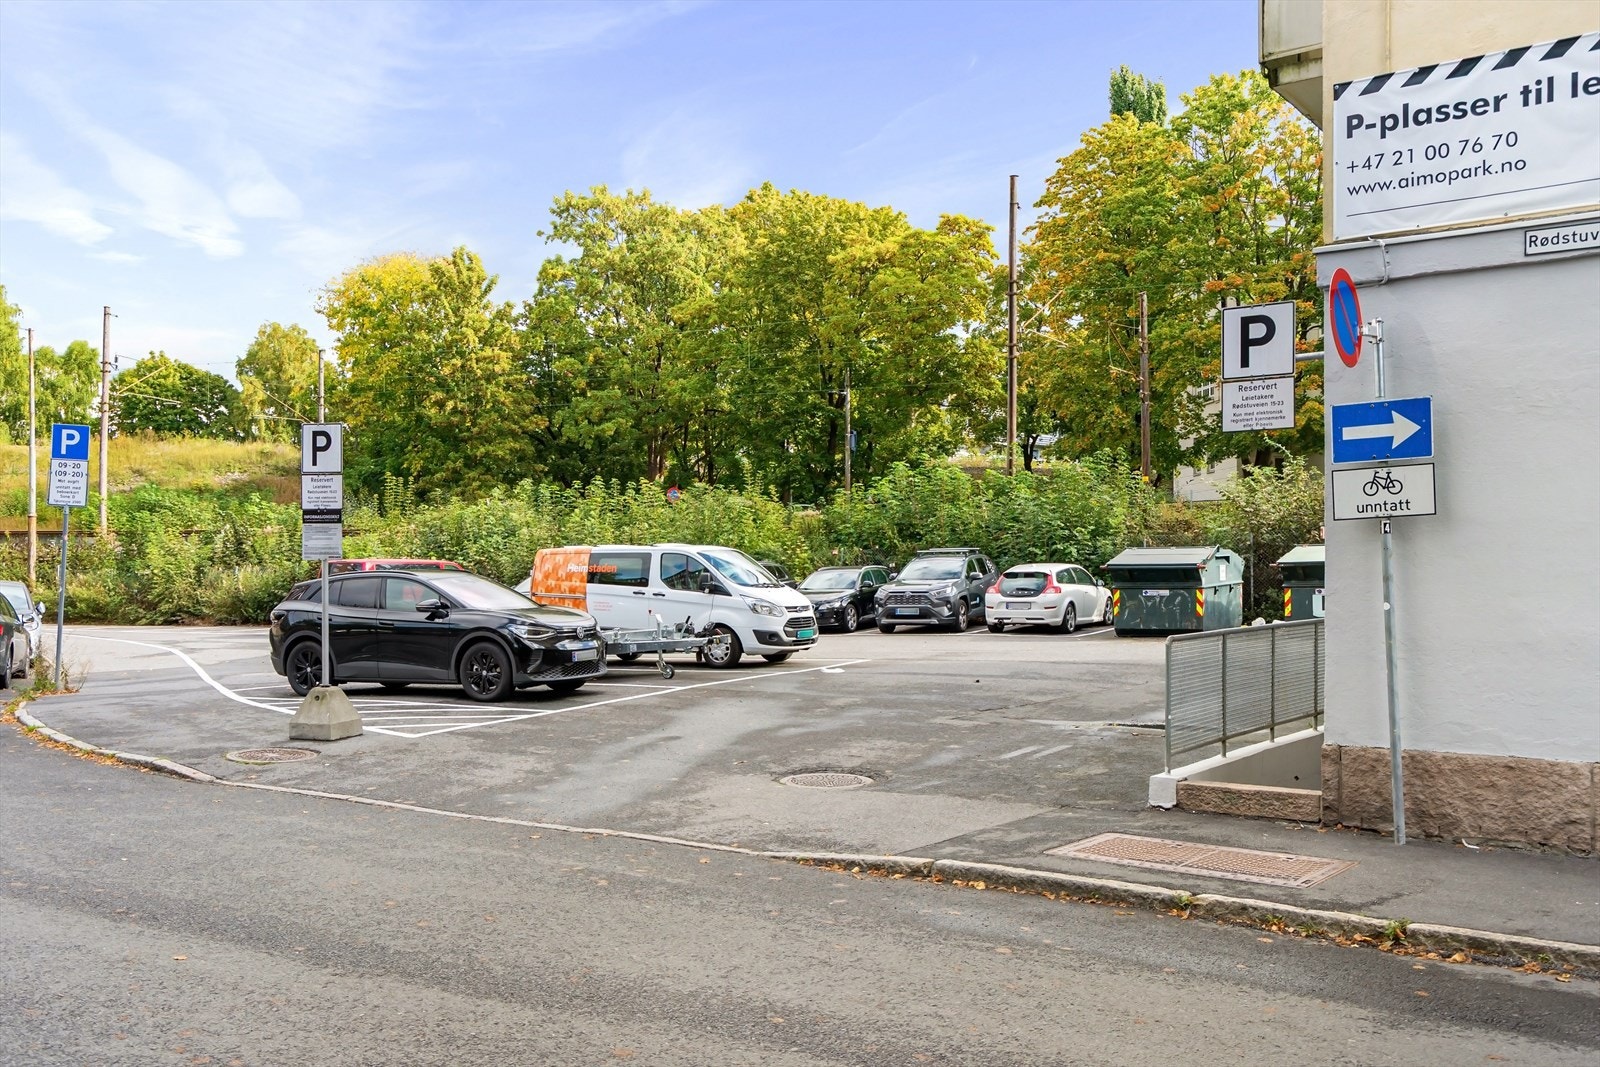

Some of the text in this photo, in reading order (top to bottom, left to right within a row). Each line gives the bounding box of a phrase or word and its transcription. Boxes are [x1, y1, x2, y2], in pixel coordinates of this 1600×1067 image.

[1346, 71, 1600, 139] P-plasser til le
[1346, 131, 1519, 173] +47 21 00 76 70
[1346, 159, 1527, 196] www.aimopark.no
[1528, 230, 1600, 248] Rødstuv
[1240, 314, 1276, 369] P
[1238, 382, 1278, 393] Reservert
[1241, 393, 1274, 401] Leietakere
[61, 429, 80, 455] P
[312, 430, 332, 467] P
[1356, 499, 1411, 514] unntatt
[566, 563, 617, 573] Heimstaden
